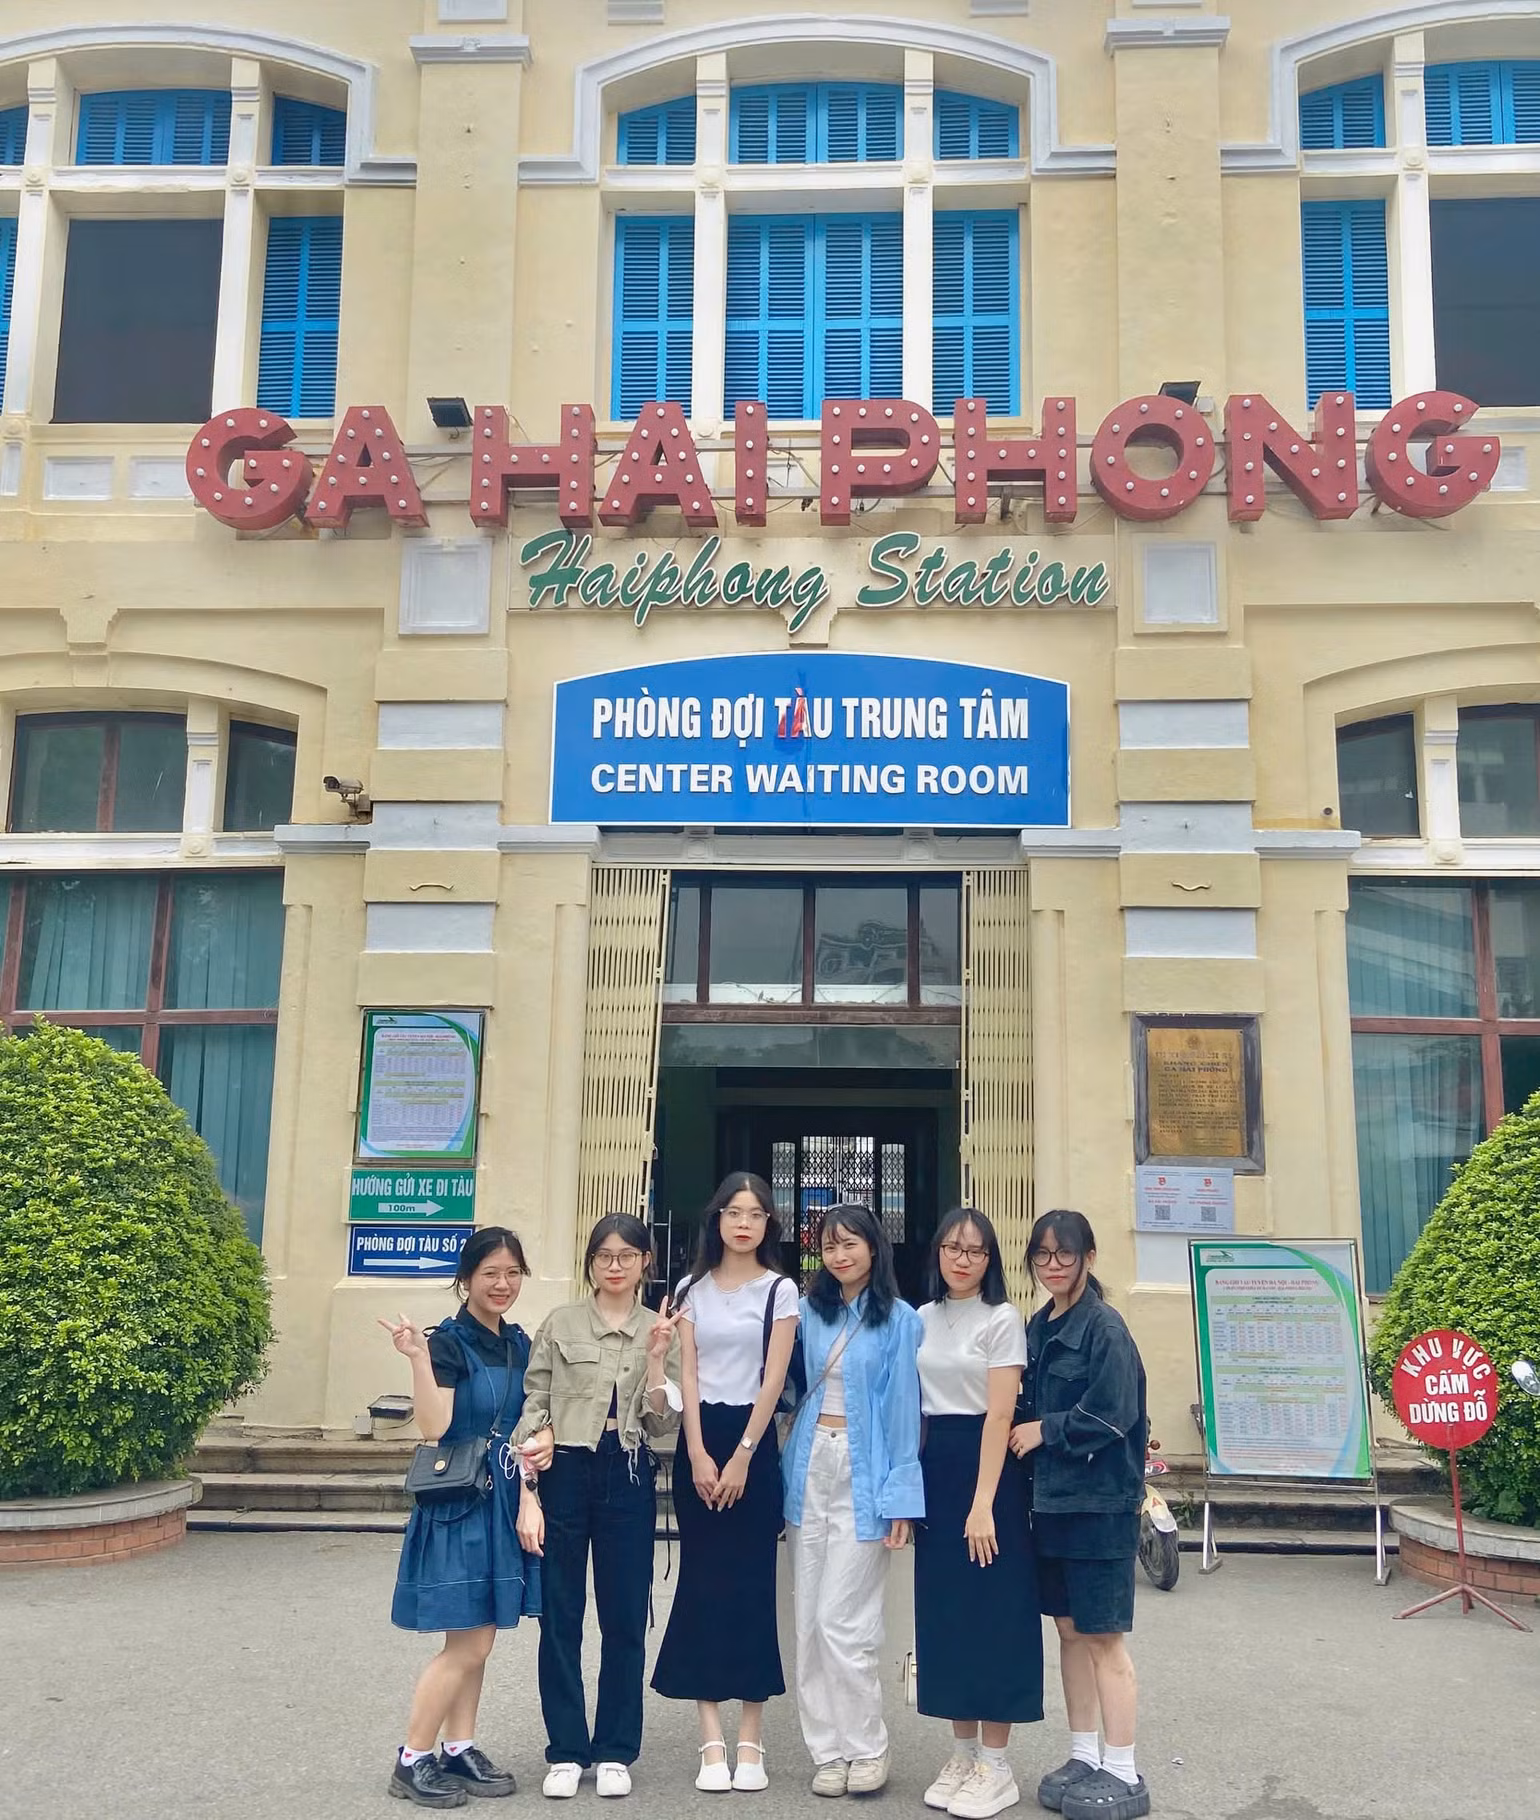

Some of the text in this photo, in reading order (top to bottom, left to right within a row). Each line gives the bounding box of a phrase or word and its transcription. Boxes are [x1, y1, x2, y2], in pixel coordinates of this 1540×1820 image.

[187, 390, 1501, 532] GA HAI PHONG
[519, 527, 1111, 635] Haiphong Station
[592, 687, 1030, 748] PHÒNG ĐỢI TÀU TRUNG TÂM
[590, 762, 1030, 795] CENTER WAITING ROOM
[351, 1172, 473, 1197] HƯỚNG GỬI XE ĐI TÀU
[388, 1204, 415, 1212] 100m
[356, 1233, 394, 1251] PHÒNG
[396, 1236, 416, 1254] ĐỢI
[419, 1234, 440, 1252] TÀU
[442, 1233, 458, 1253] SỐ
[1400, 1337, 1492, 1380] KHU VỰC
[1424, 1369, 1470, 1396] CẤM
[1409, 1388, 1488, 1424] DỪNG ĐỖ
